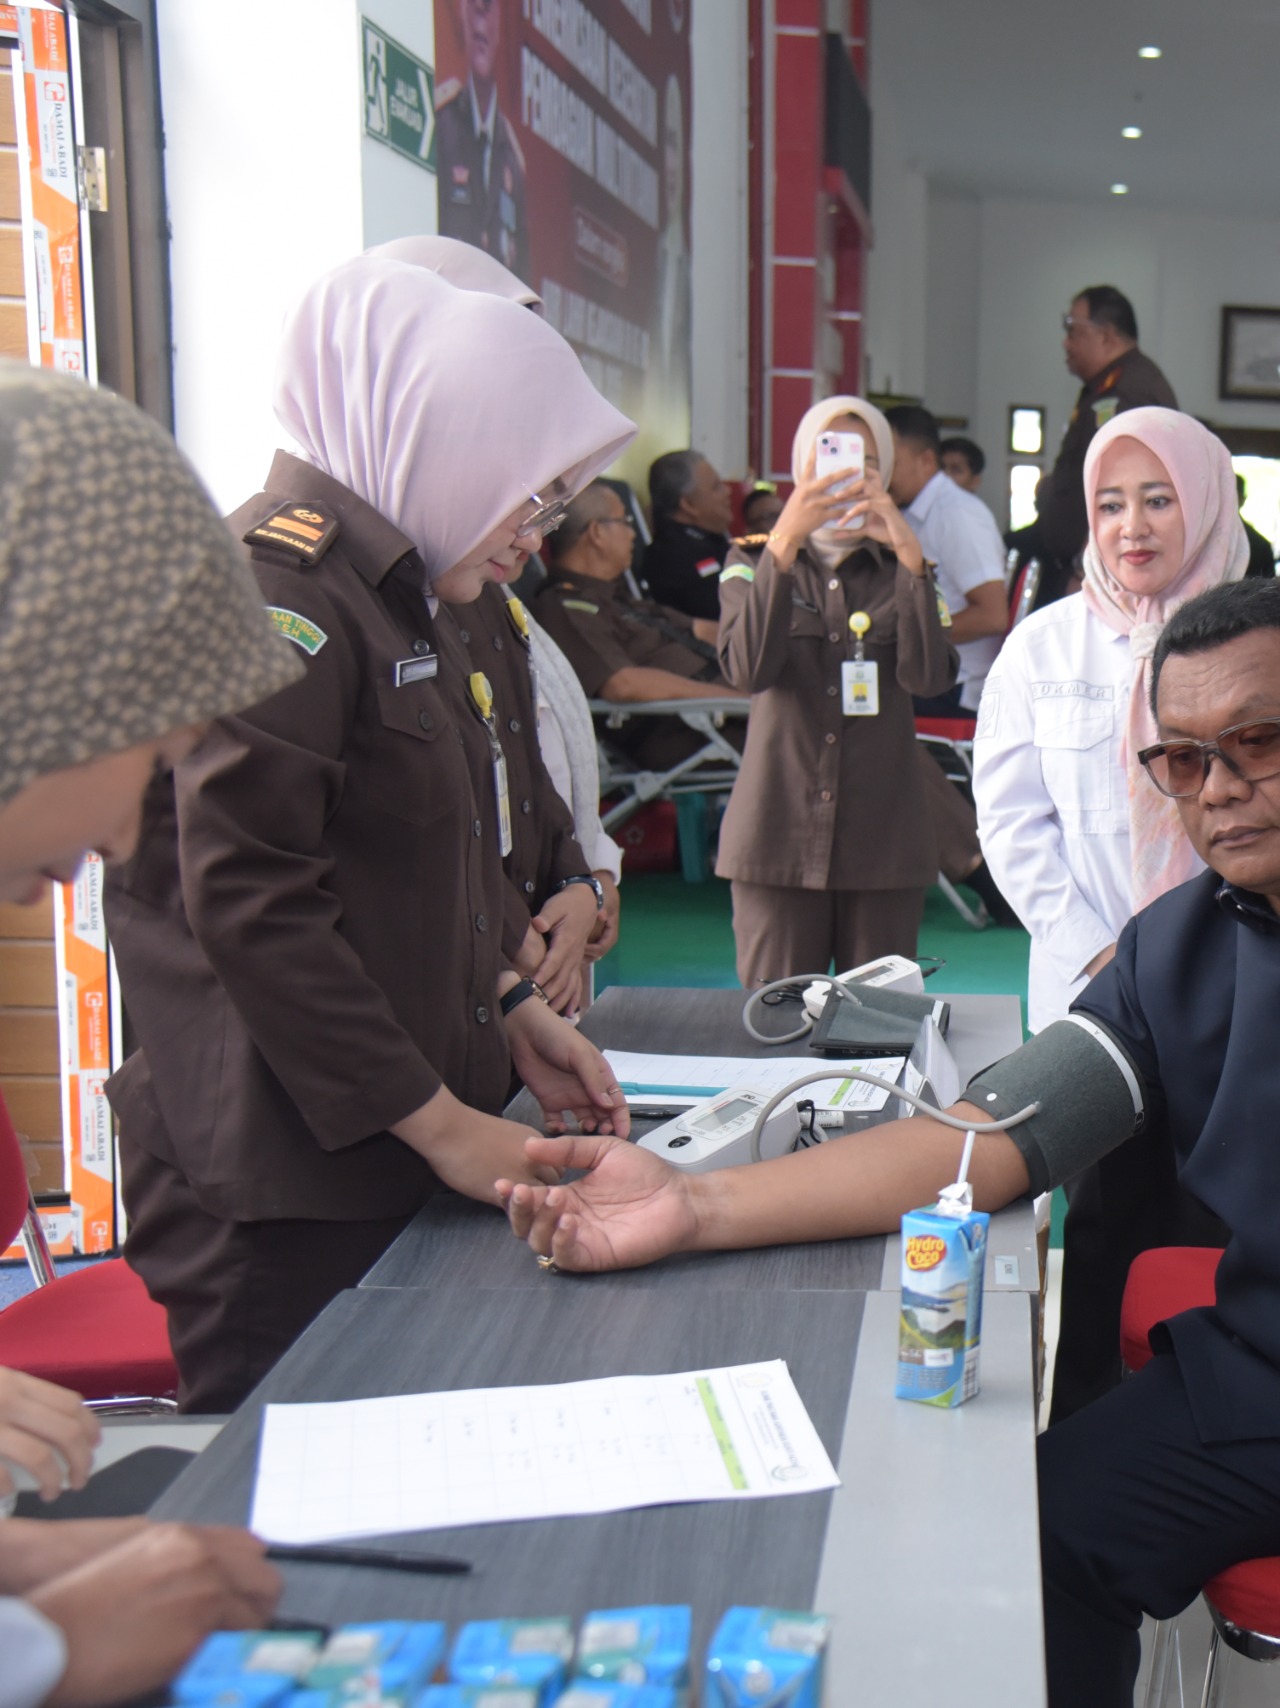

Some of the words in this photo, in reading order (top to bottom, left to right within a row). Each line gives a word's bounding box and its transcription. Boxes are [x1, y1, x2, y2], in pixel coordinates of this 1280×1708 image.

[55, 102, 65, 141] DAMAI
[57, 143, 68, 178] ABADI
[295, 619, 321, 644] TINGGI
[89, 863, 97, 897] DAMAI
[91, 899, 99, 930] ABADI
[96, 1096, 105, 1129] DAMAI
[97, 1131, 105, 1161] ABADI
[906, 1236, 945, 1253] Hydro
[906, 1251, 940, 1270] Coco
